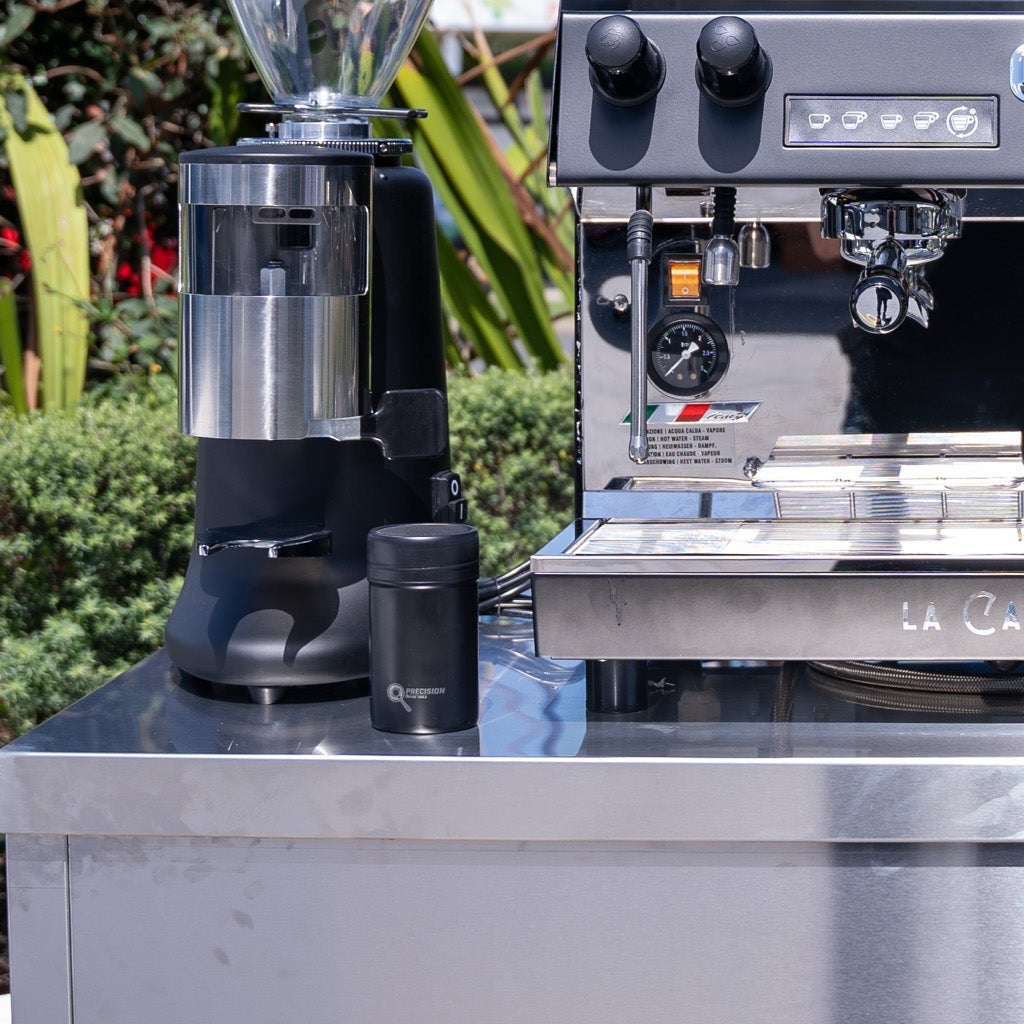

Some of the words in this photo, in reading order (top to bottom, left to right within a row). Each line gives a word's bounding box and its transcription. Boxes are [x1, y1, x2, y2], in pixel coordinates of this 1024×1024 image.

[707, 412, 744, 421] Italy
[902, 601, 941, 630] LA
[405, 687, 445, 695] PRECISION
